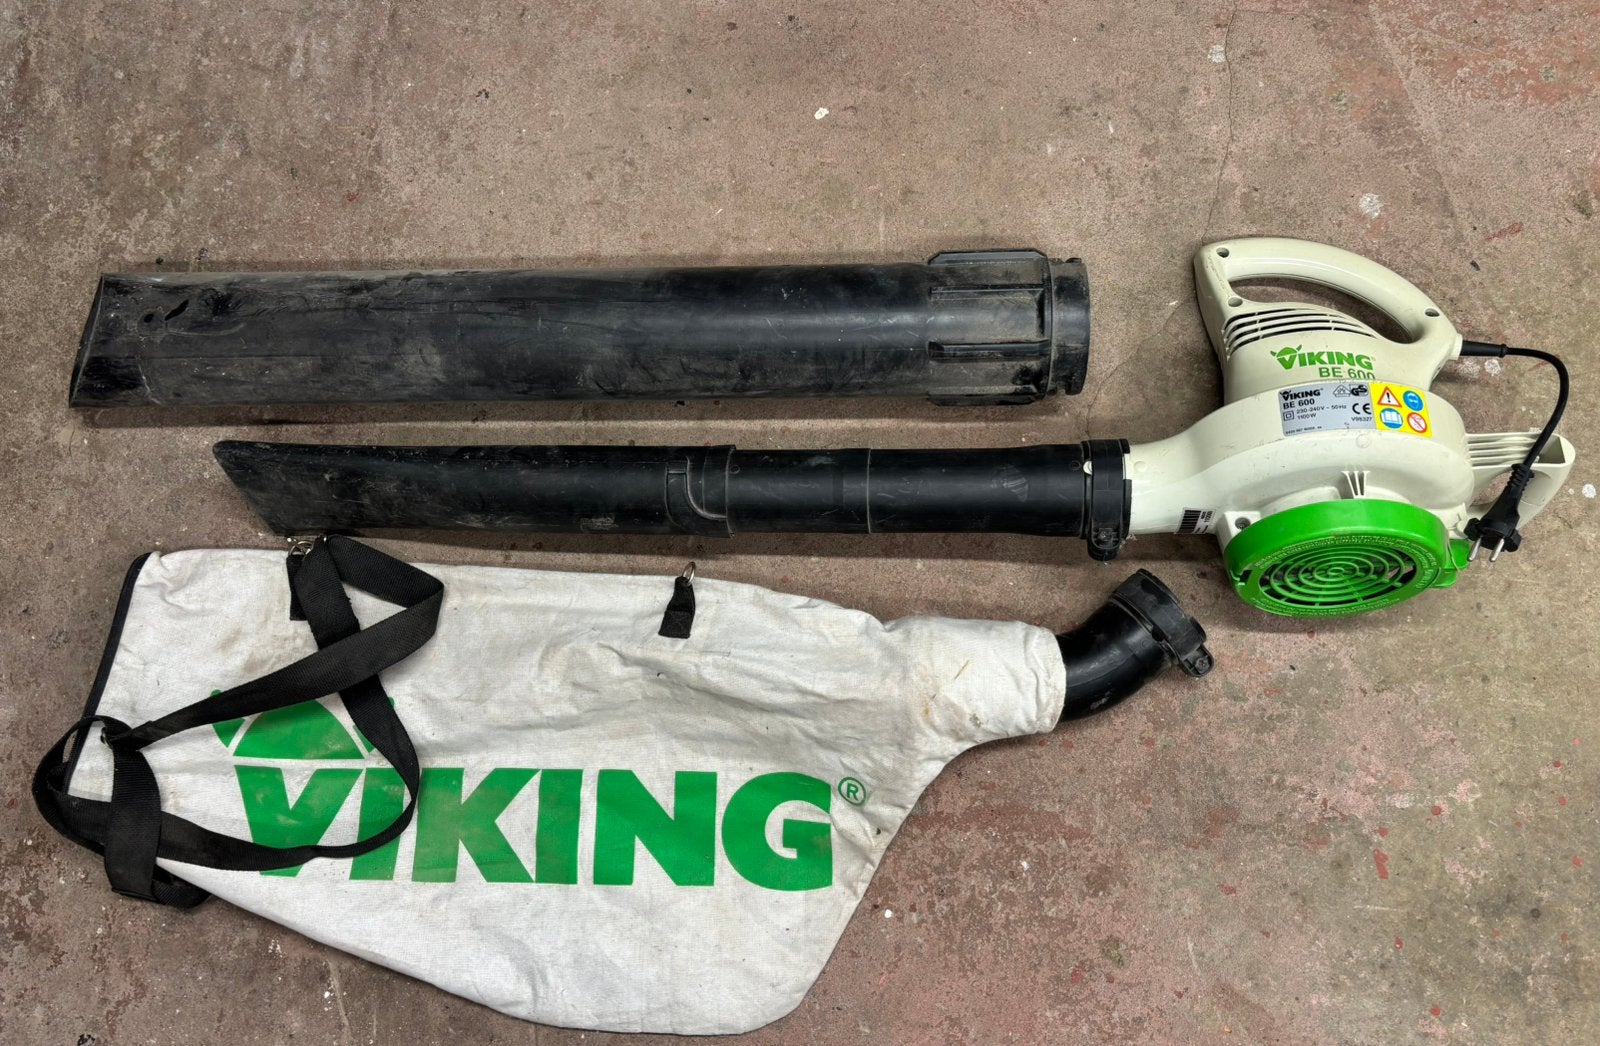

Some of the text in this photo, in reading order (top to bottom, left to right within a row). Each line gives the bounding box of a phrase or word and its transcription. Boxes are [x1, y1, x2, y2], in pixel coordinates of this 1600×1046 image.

[1277, 351, 1374, 370] VIKING
[1318, 367, 1343, 378] BE
[1282, 389, 1321, 401] VIKING
[1283, 398, 1315, 410] BE 600
